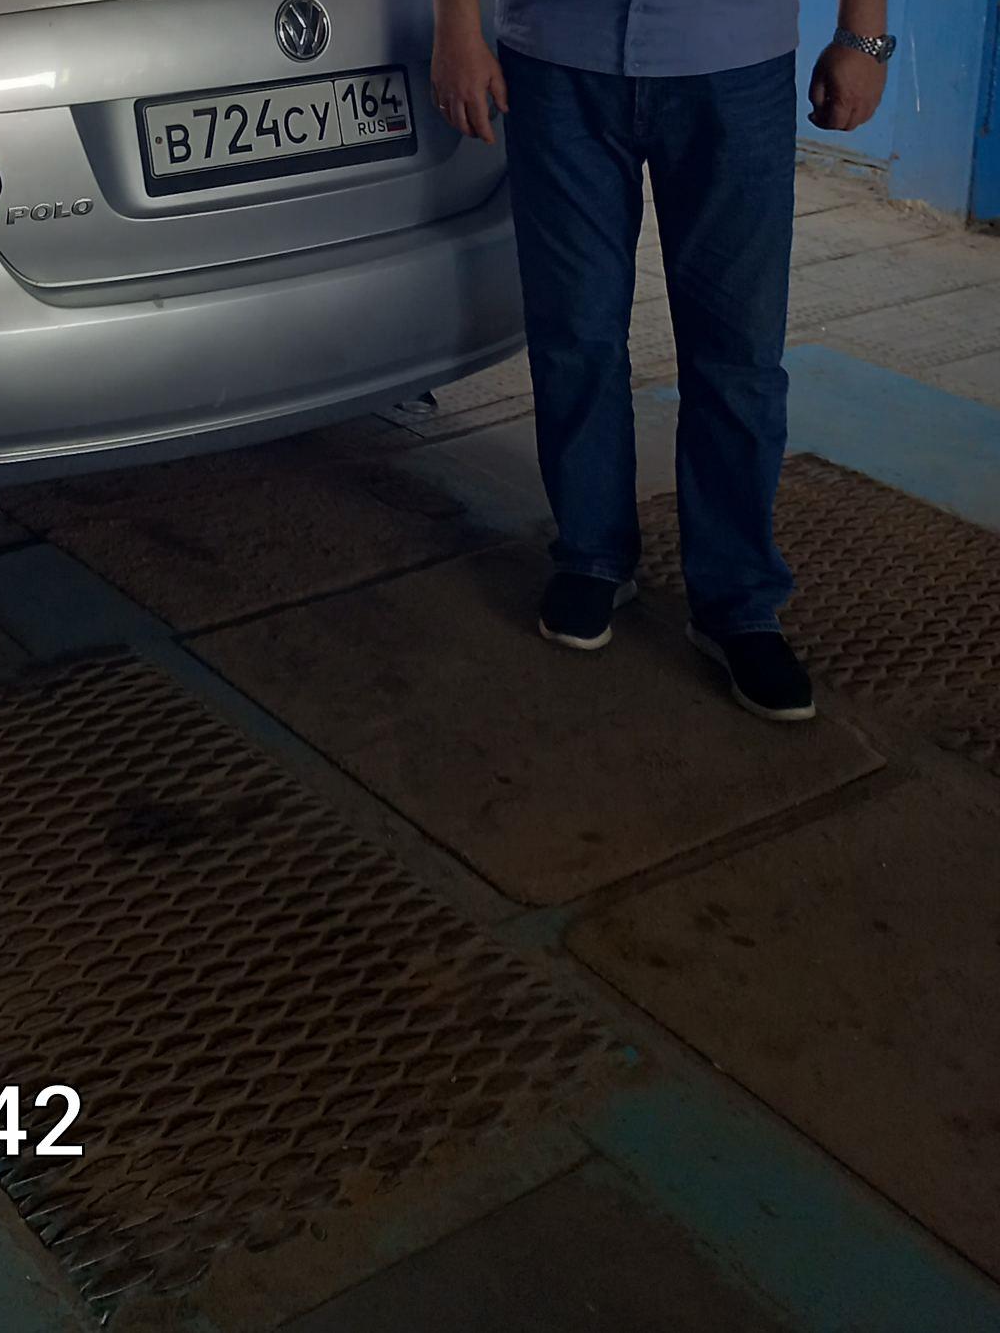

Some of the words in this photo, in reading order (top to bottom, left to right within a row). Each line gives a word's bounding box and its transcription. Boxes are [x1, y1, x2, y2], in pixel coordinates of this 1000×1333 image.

[341, 77, 402, 122] 164
[358, 119, 386, 136] RUS
[6, 198, 94, 225] POLO
